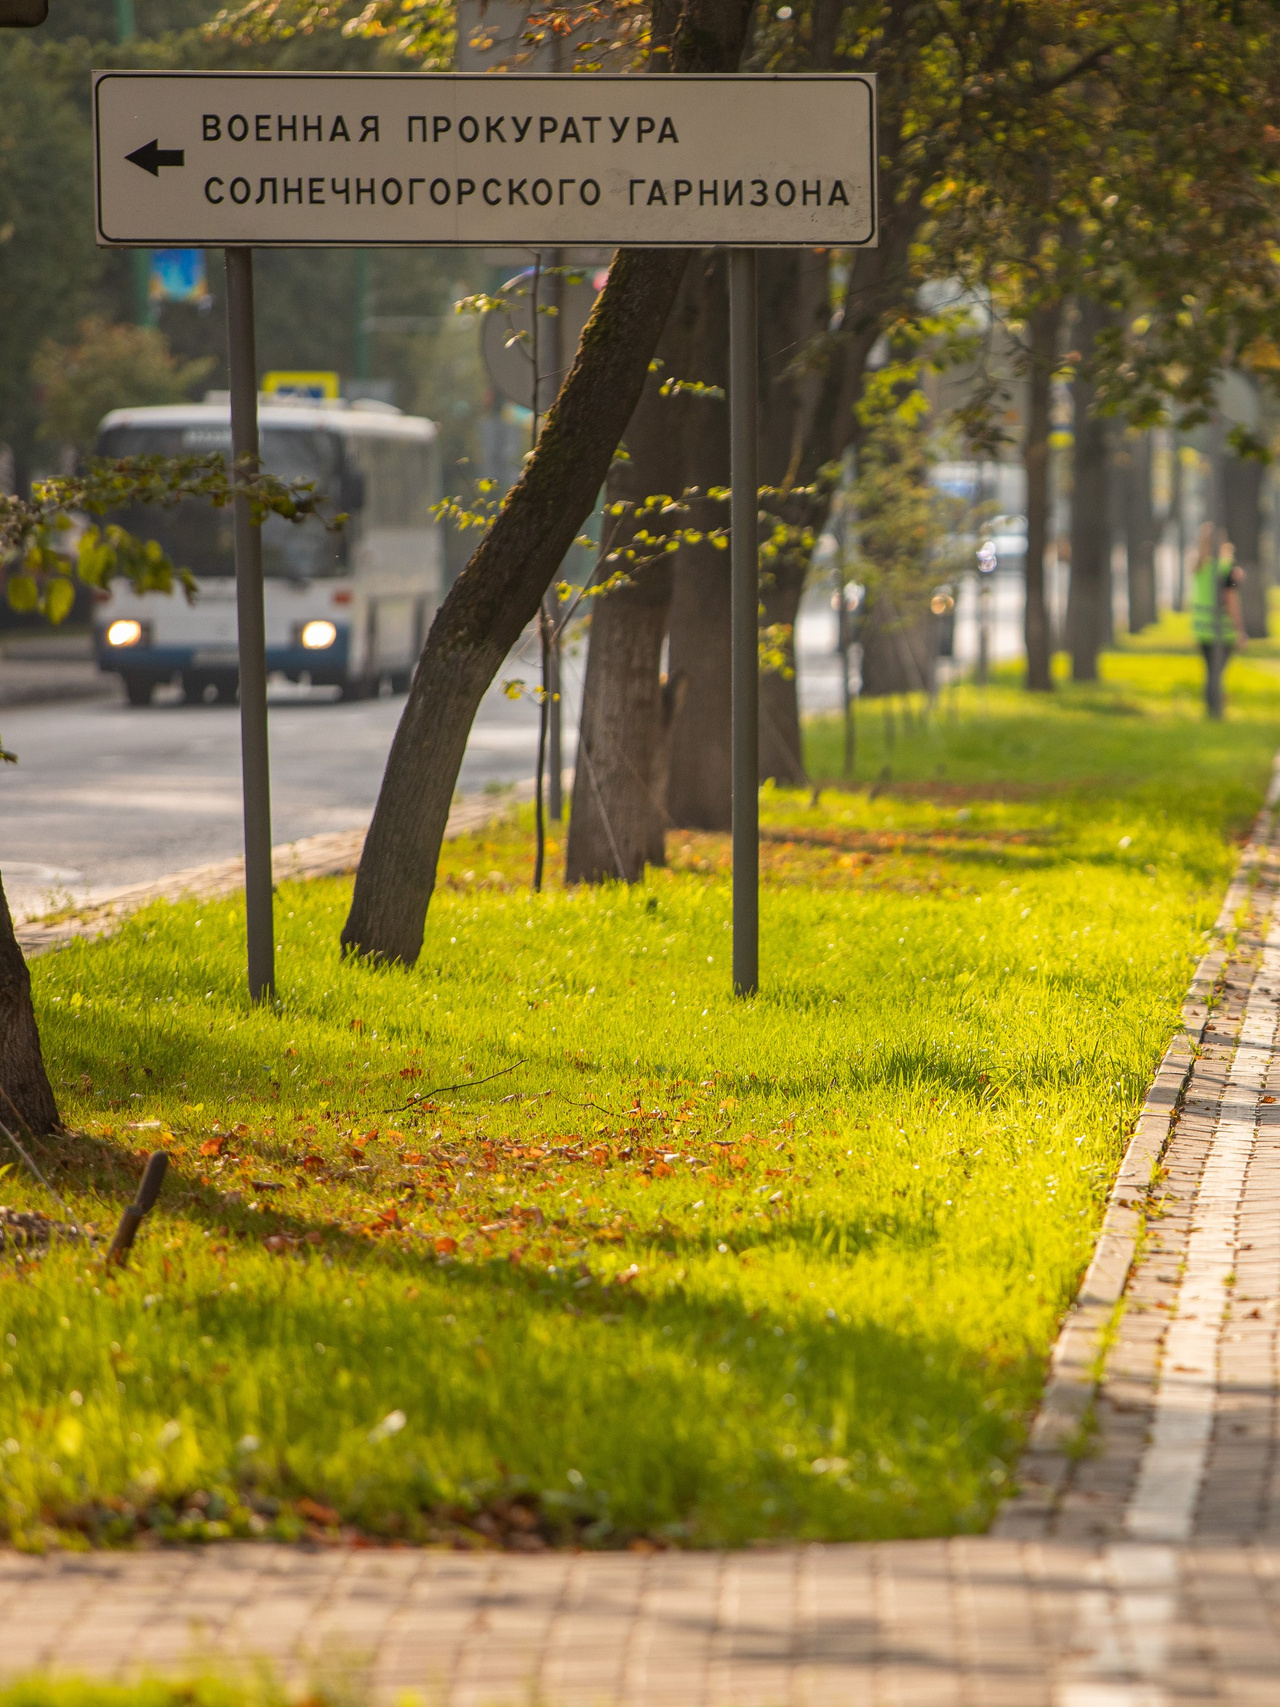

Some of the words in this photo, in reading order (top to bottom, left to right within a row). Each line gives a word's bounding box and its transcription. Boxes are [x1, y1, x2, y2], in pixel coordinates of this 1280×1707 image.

[201, 113, 380, 143] ВОЕННАЯ
[407, 115, 680, 144] ПРОКУРАТУРА
[203, 176, 602, 207] СОЛНЕЧНОГОРСКОГО
[628, 178, 851, 208] ГАРНИЗОНА
